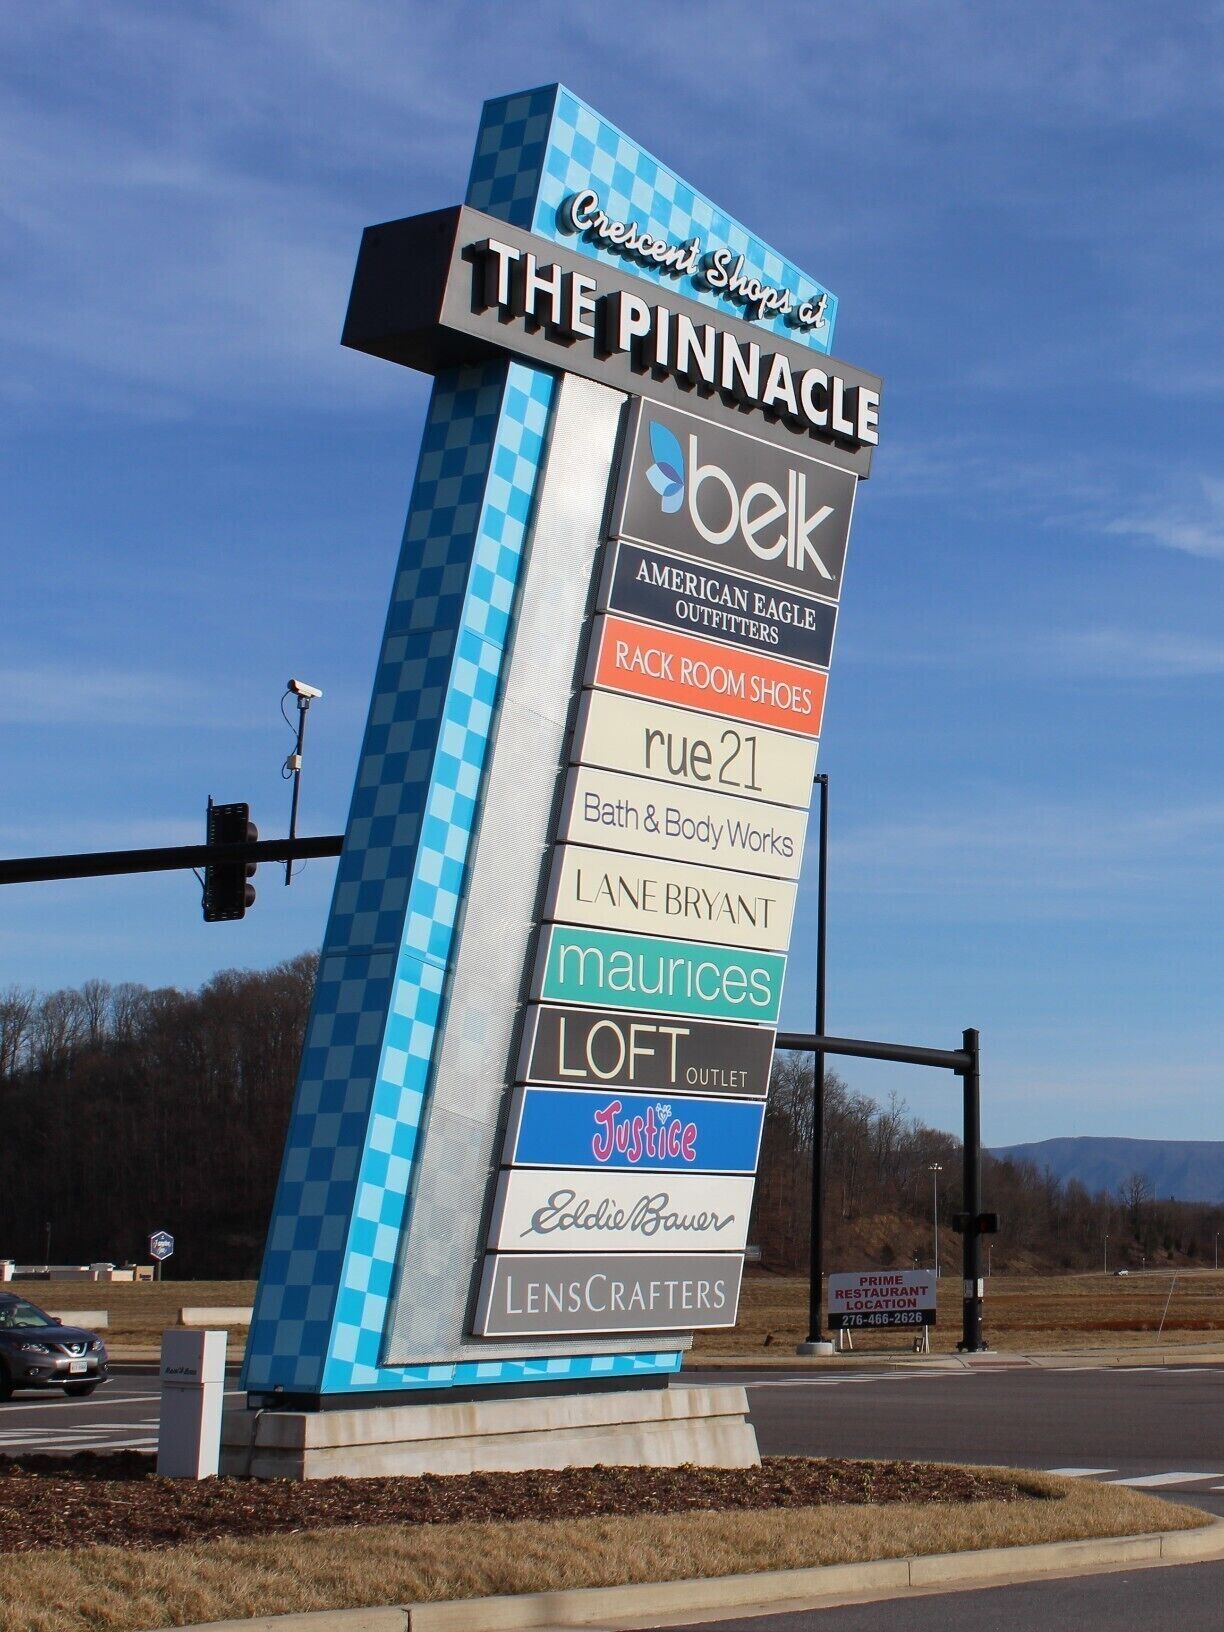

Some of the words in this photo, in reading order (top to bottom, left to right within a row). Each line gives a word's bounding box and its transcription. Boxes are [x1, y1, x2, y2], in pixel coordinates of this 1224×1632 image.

[572, 189, 700, 274] Crescent
[706, 248, 792, 320] Shops
[799, 293, 828, 328] at
[486, 238, 597, 338] THE
[619, 290, 880, 446] PINNACLE
[689, 433, 835, 581] belk
[635, 559, 749, 611] AMERICAN
[753, 593, 816, 631] EAGLE
[675, 599, 779, 645] OUTFITTERS
[615, 640, 674, 682] RACK
[680, 657, 745, 699] ROOM
[750, 675, 812, 715] SHOES
[584, 792, 639, 831] Bath
[644, 804, 660, 834] &
[665, 808, 723, 850] Body
[726, 818, 794, 858] Works
[576, 868, 658, 913] LANE
[665, 883, 776, 929] BRYANT
[559, 944, 771, 1007] maurices
[559, 1017, 690, 1083] LOFT
[686, 1067, 748, 1088] OUTLET
[592, 1100, 698, 1163] Justice
[520, 1189, 630, 1237] Eddie
[628, 1192, 735, 1236] Bauer
[835, 1286, 928, 1299] RESTAURANT
[846, 1298, 917, 1311] LOCATION
[860, 1275, 903, 1286] PRIME
[842, 1312, 923, 1326] 276-466-2626
